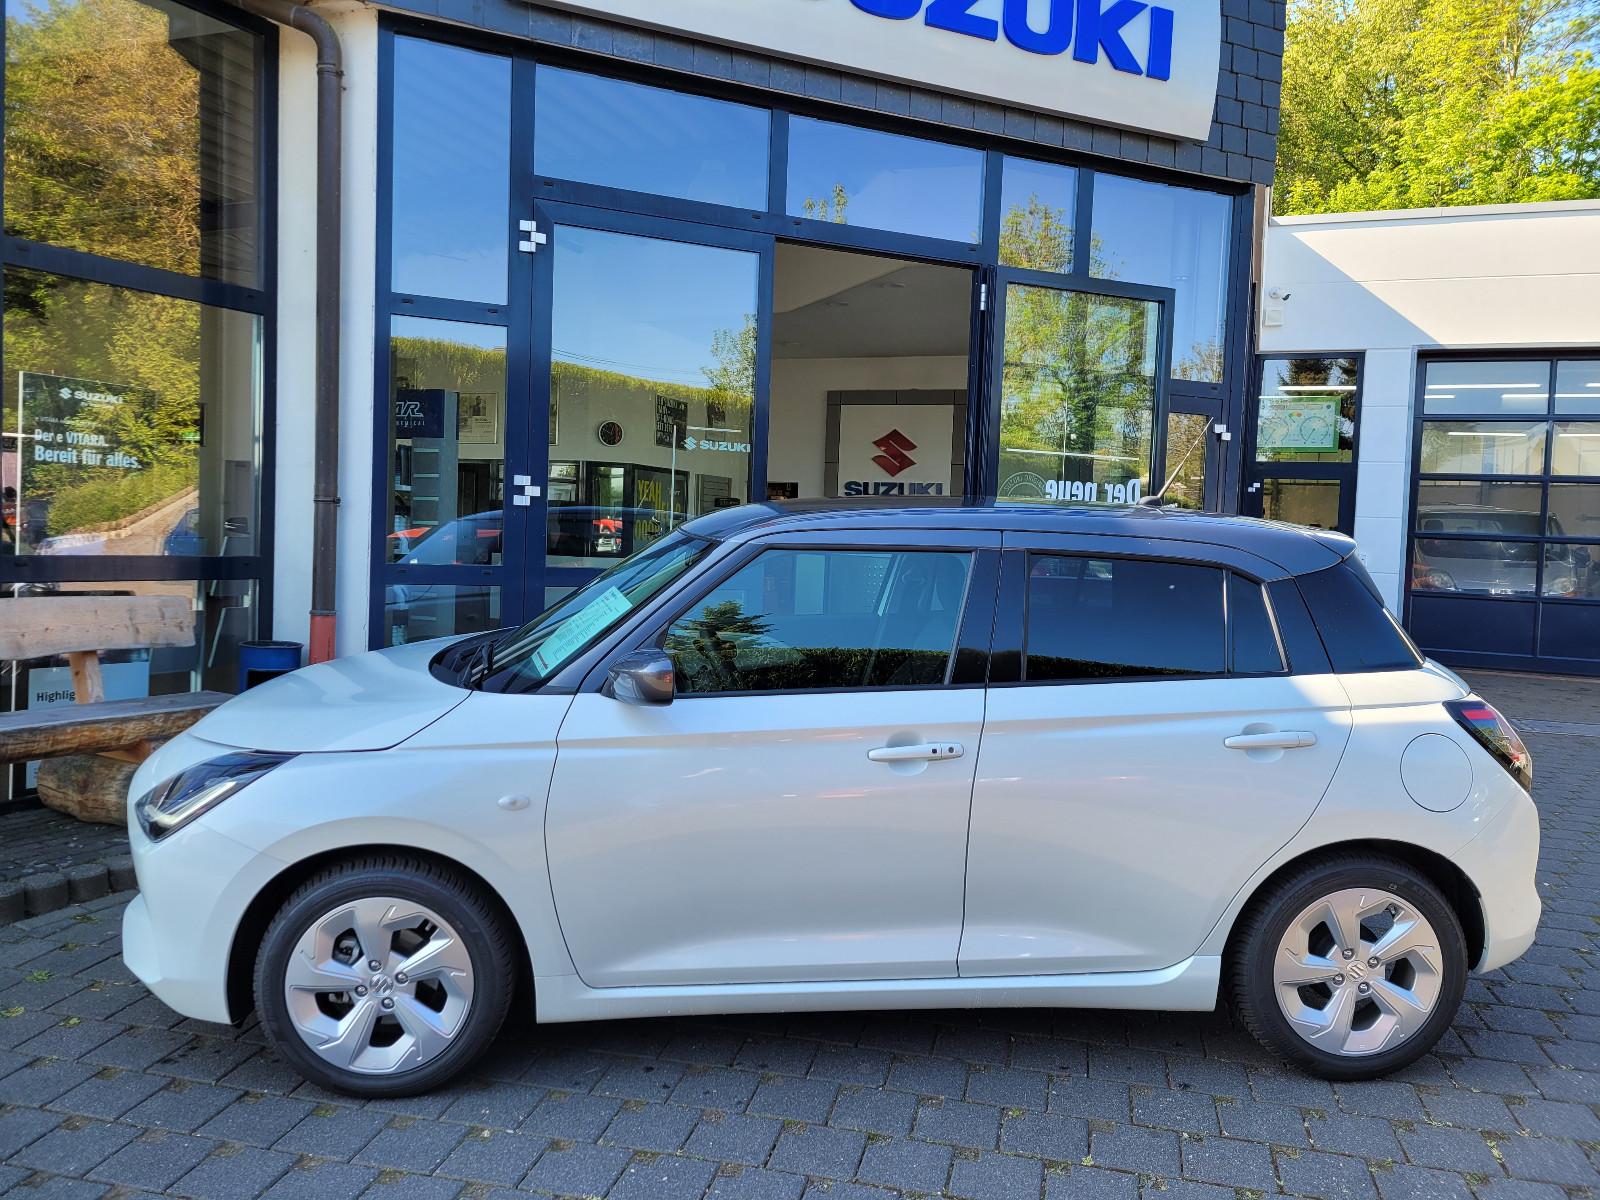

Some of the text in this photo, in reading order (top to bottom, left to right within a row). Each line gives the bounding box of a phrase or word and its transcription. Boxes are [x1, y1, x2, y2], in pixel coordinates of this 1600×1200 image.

[847, 0, 1174, 81] UKI
[34, 428, 54, 442] Der
[56, 433, 63, 442] e
[700, 439, 750, 453] SUZUKI
[34, 445, 78, 464] Bereit
[82, 448, 103, 465] für
[844, 481, 943, 497] SUZUKI
[36, 690, 76, 703] Highlig
